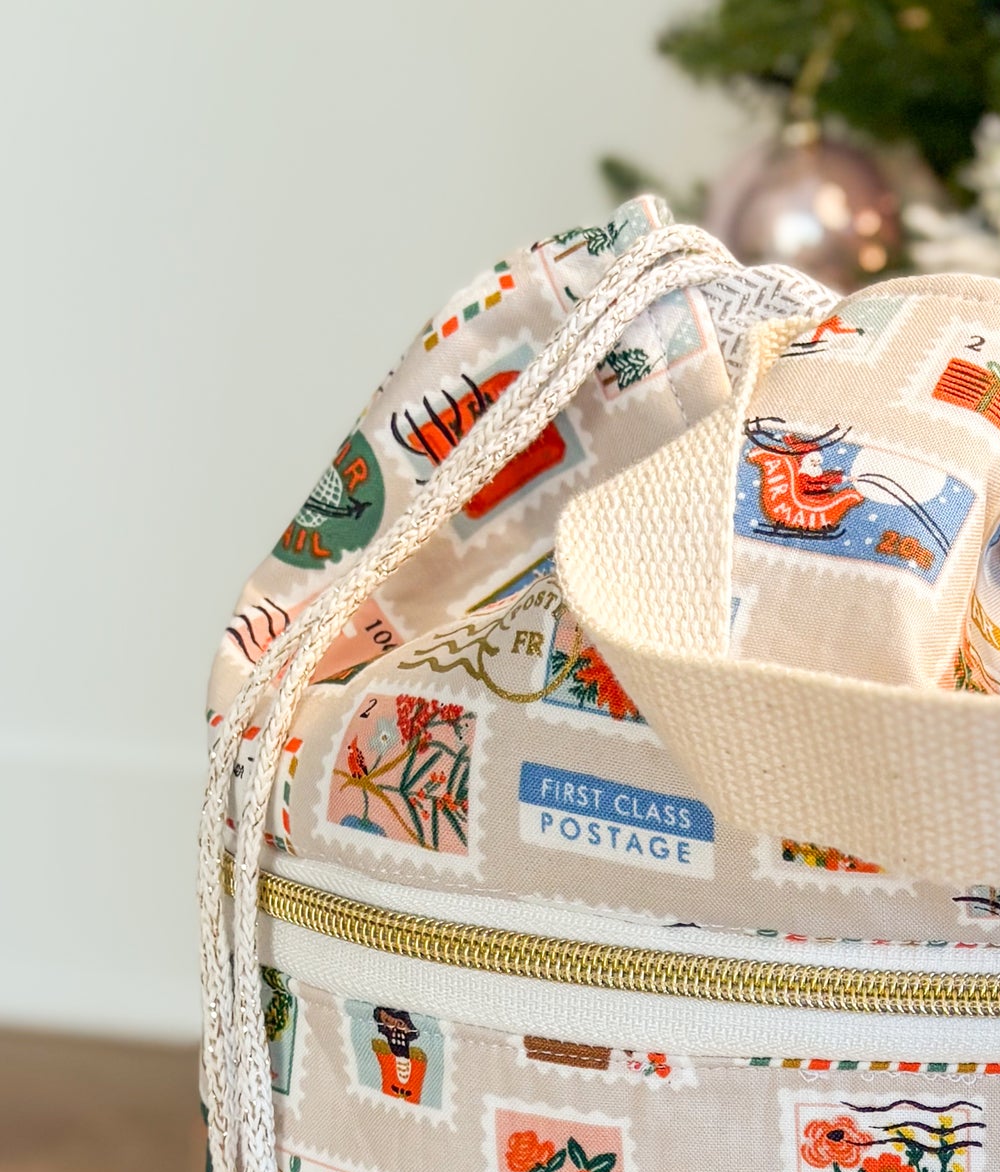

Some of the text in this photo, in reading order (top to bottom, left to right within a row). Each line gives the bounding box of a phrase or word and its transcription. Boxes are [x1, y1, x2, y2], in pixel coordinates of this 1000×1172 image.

[964, 335, 986, 352] 2
[765, 458, 830, 531] AIR MAIL
[511, 629, 544, 657] FR
[359, 697, 379, 719] 2
[540, 778, 693, 831] FIRST CLASS
[540, 811, 692, 865] POSTAGE
